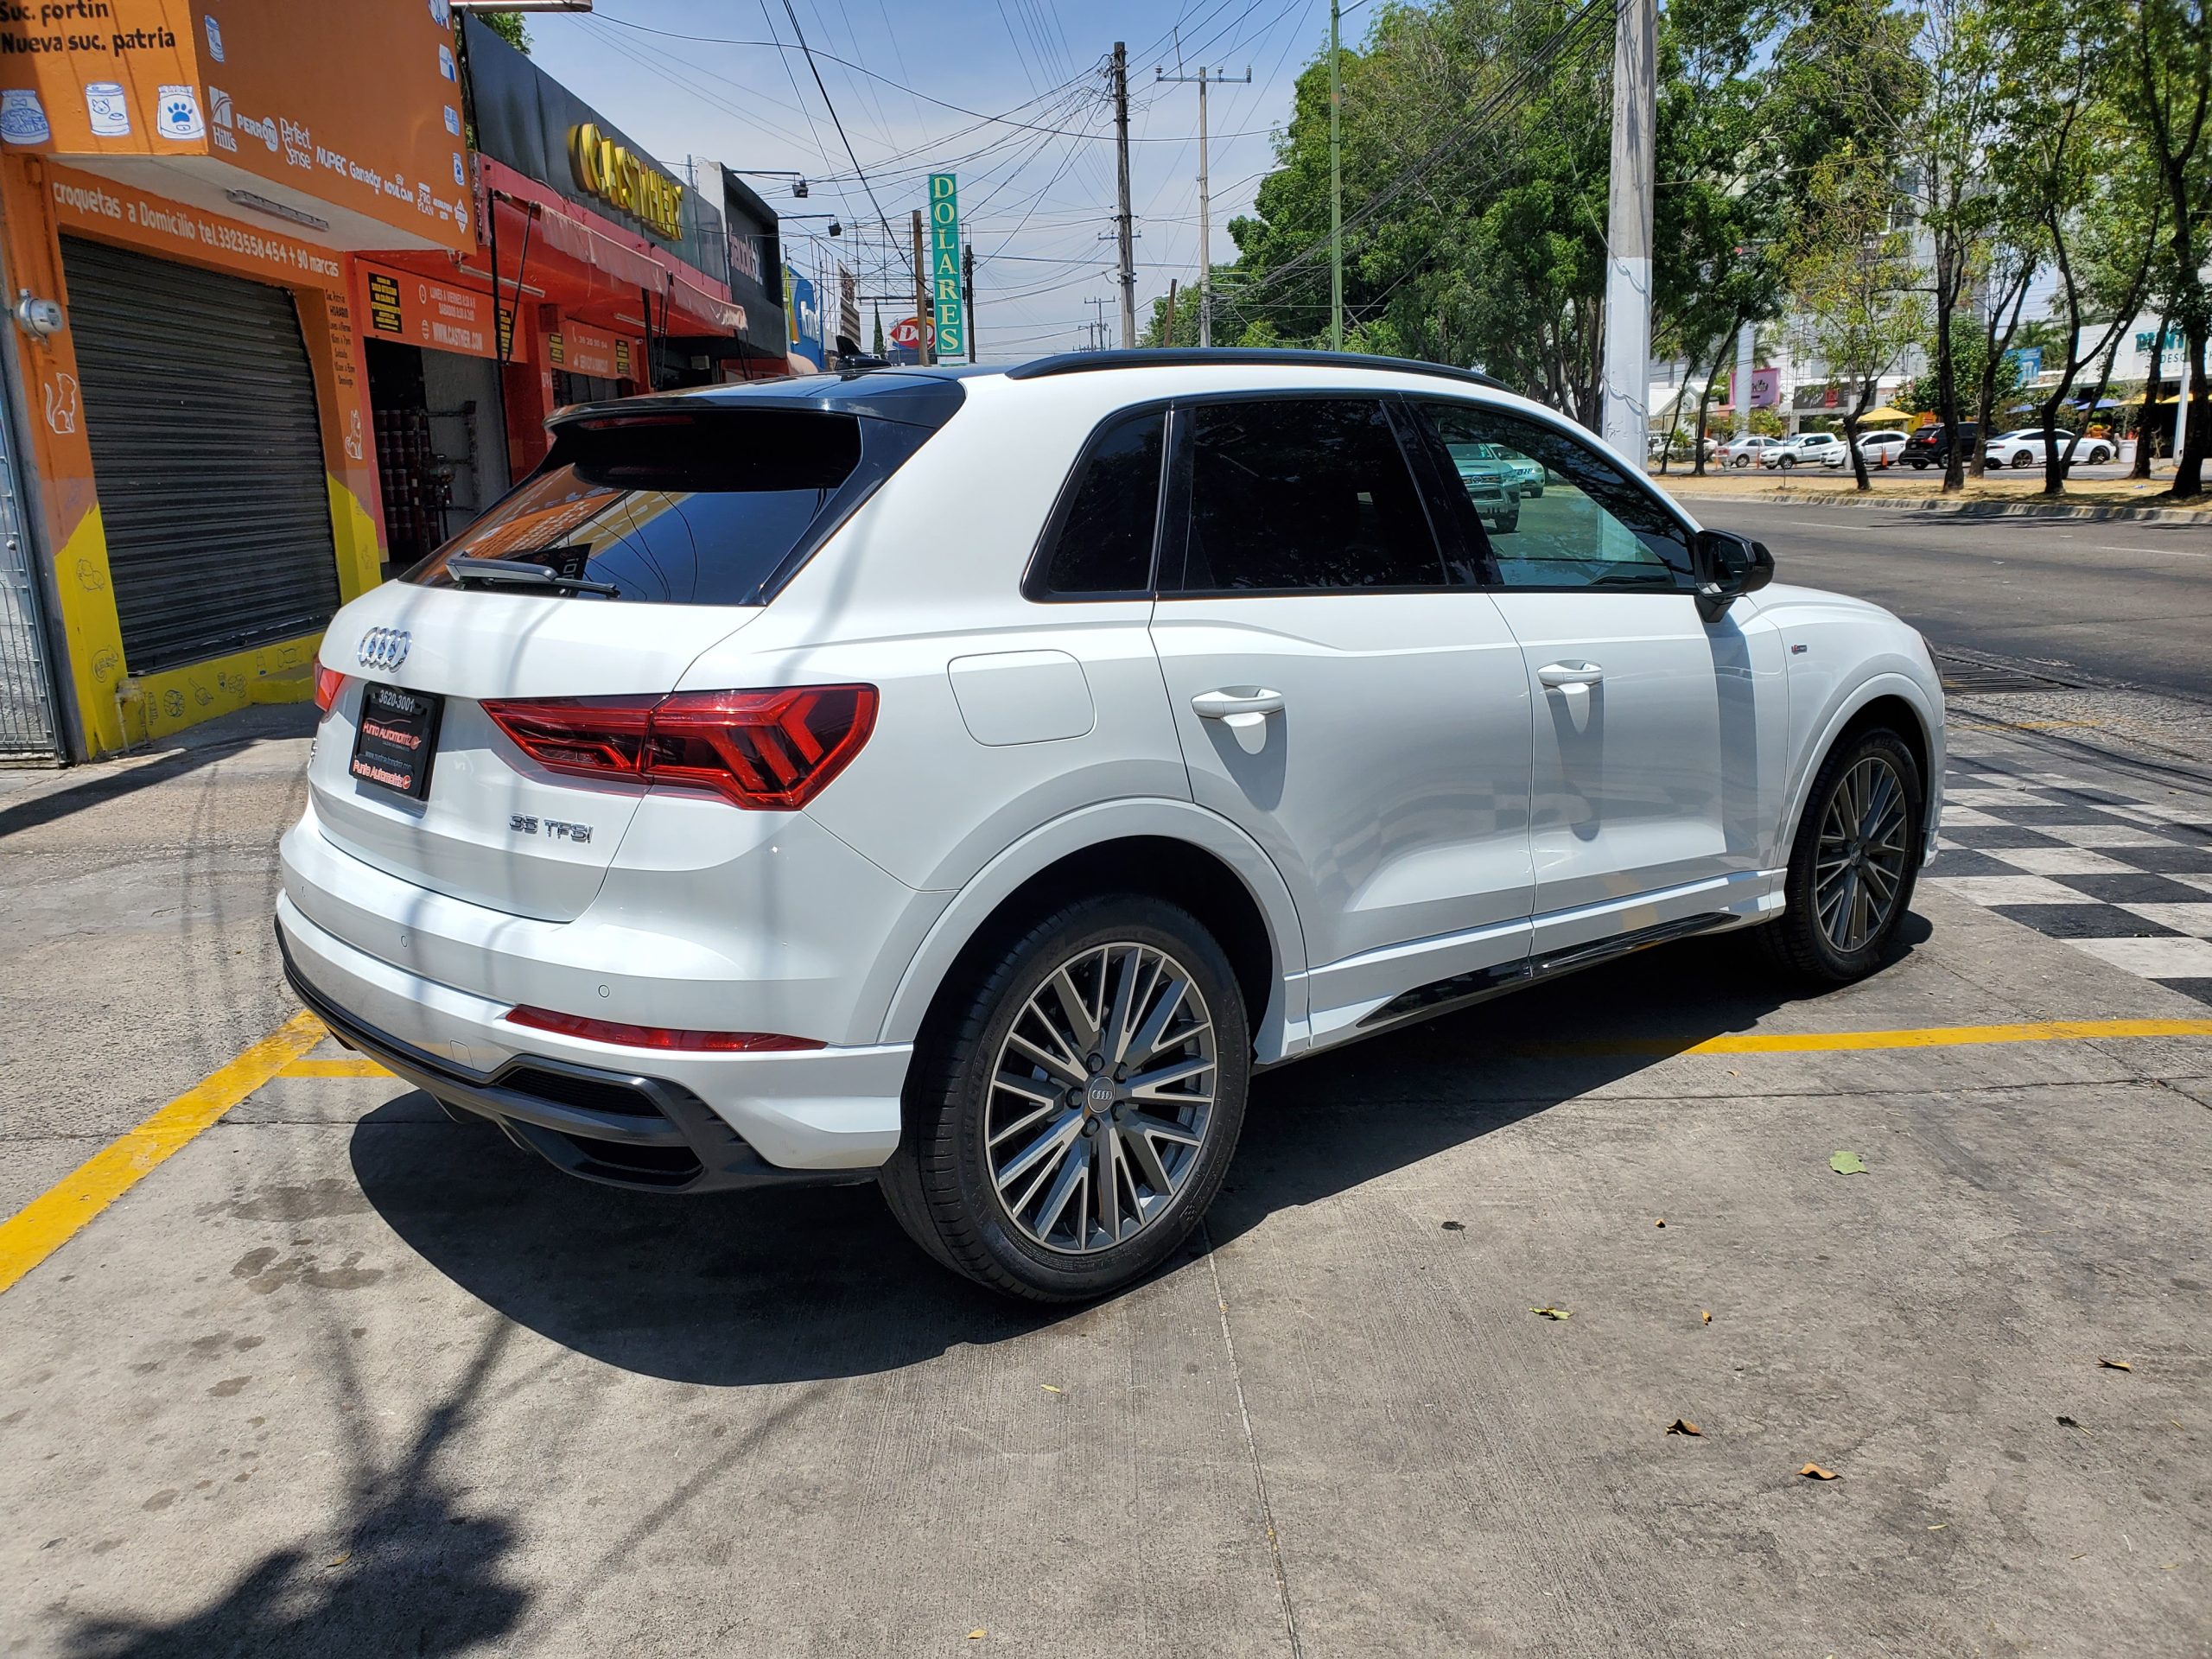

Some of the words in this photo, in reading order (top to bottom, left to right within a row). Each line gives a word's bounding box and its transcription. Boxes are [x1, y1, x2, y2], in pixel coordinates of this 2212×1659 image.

[1, 33, 62, 54] Nueva
[68, 34, 106, 51] suc.
[112, 27, 175, 57] patria
[213, 125, 237, 152] Hill's
[279, 118, 312, 149] Perfect
[316, 146, 346, 176] NUPEC
[349, 161, 381, 188] Ganador
[417, 199, 434, 216] PLAN
[418, 189, 431, 205] PRO
[53, 181, 122, 219] croquetas
[126, 202, 137, 223] a
[139, 200, 196, 240] Domicilio
[296, 249, 308, 270] 90
[308, 255, 340, 277] marcas
[934, 176, 960, 350] DOLARES
[378, 690, 415, 712] 3620-3001
[353, 760, 372, 777] Punto
[370, 766, 403, 788] Automotriz
[510, 813, 538, 835] 35
[543, 817, 594, 844] TFSI
